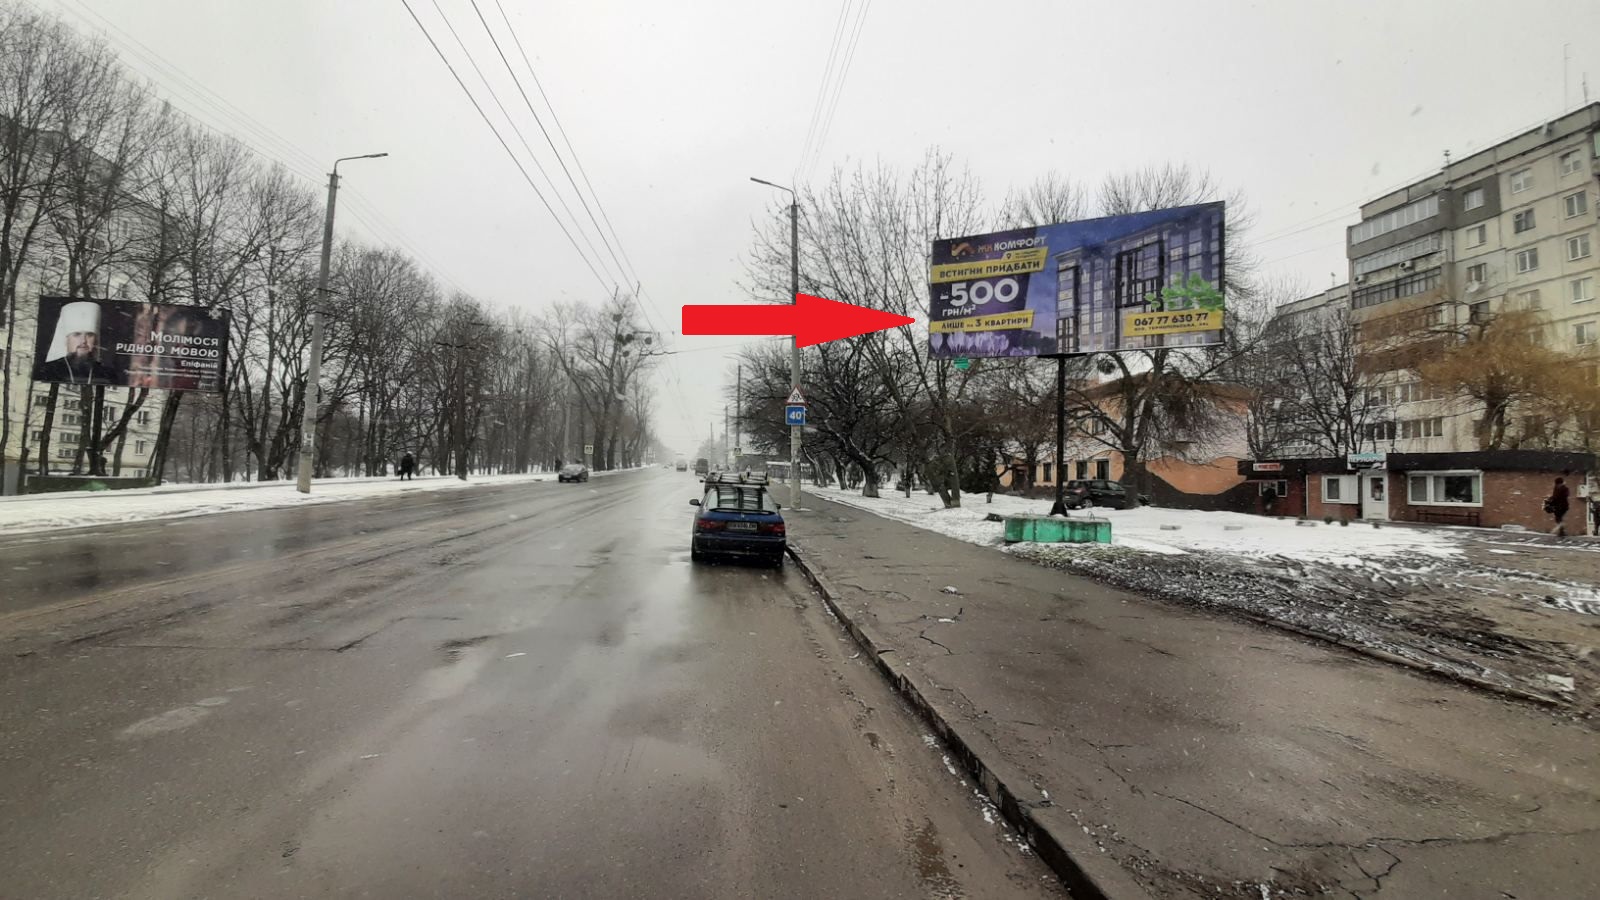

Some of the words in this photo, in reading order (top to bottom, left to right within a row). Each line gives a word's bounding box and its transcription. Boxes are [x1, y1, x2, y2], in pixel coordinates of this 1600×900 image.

[994, 236, 1047, 252] КОМФОРТ
[940, 266, 983, 278] ВСТИГНИ
[985, 261, 1040, 273] ПРИДБАТИ
[941, 321, 965, 330] ЛИШЕ
[975, 318, 982, 328] 3
[984, 317, 1029, 327] КВАРТИРИ
[1134, 317, 1154, 326] 067
[1156, 316, 1170, 324] 77
[1171, 314, 1193, 323] 630
[1195, 312, 1208, 321] 77
[180, 359, 218, 369] Епіфаній
[789, 411, 802, 420] 40
